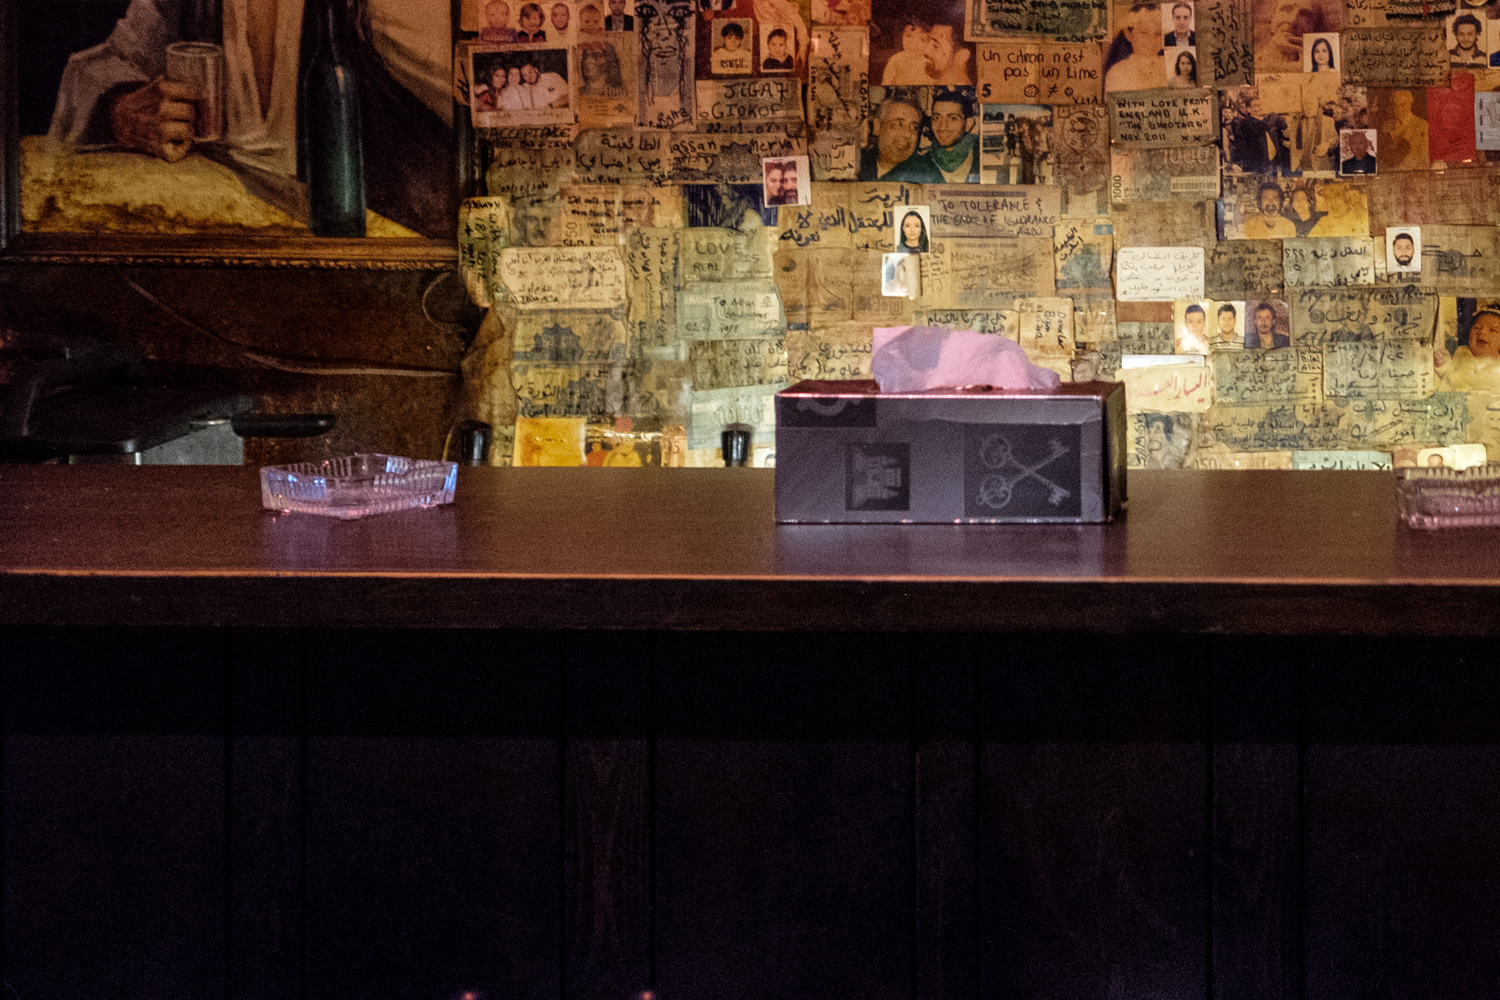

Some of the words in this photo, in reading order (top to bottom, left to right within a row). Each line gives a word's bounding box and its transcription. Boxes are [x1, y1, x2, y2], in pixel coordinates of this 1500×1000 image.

[1003, 66, 1030, 82] pas
[1041, 66, 1060, 80] un
[981, 83, 992, 98] 5
[1116, 99, 1145, 108] WITH
[1151, 99, 1179, 108] LOVE
[1183, 98, 1209, 106] FROM
[1118, 108, 1171, 120] ENGLAND
[939, 198, 955, 212] TO
[964, 197, 1030, 212] TOLERANCE
[930, 213, 950, 225] THE
